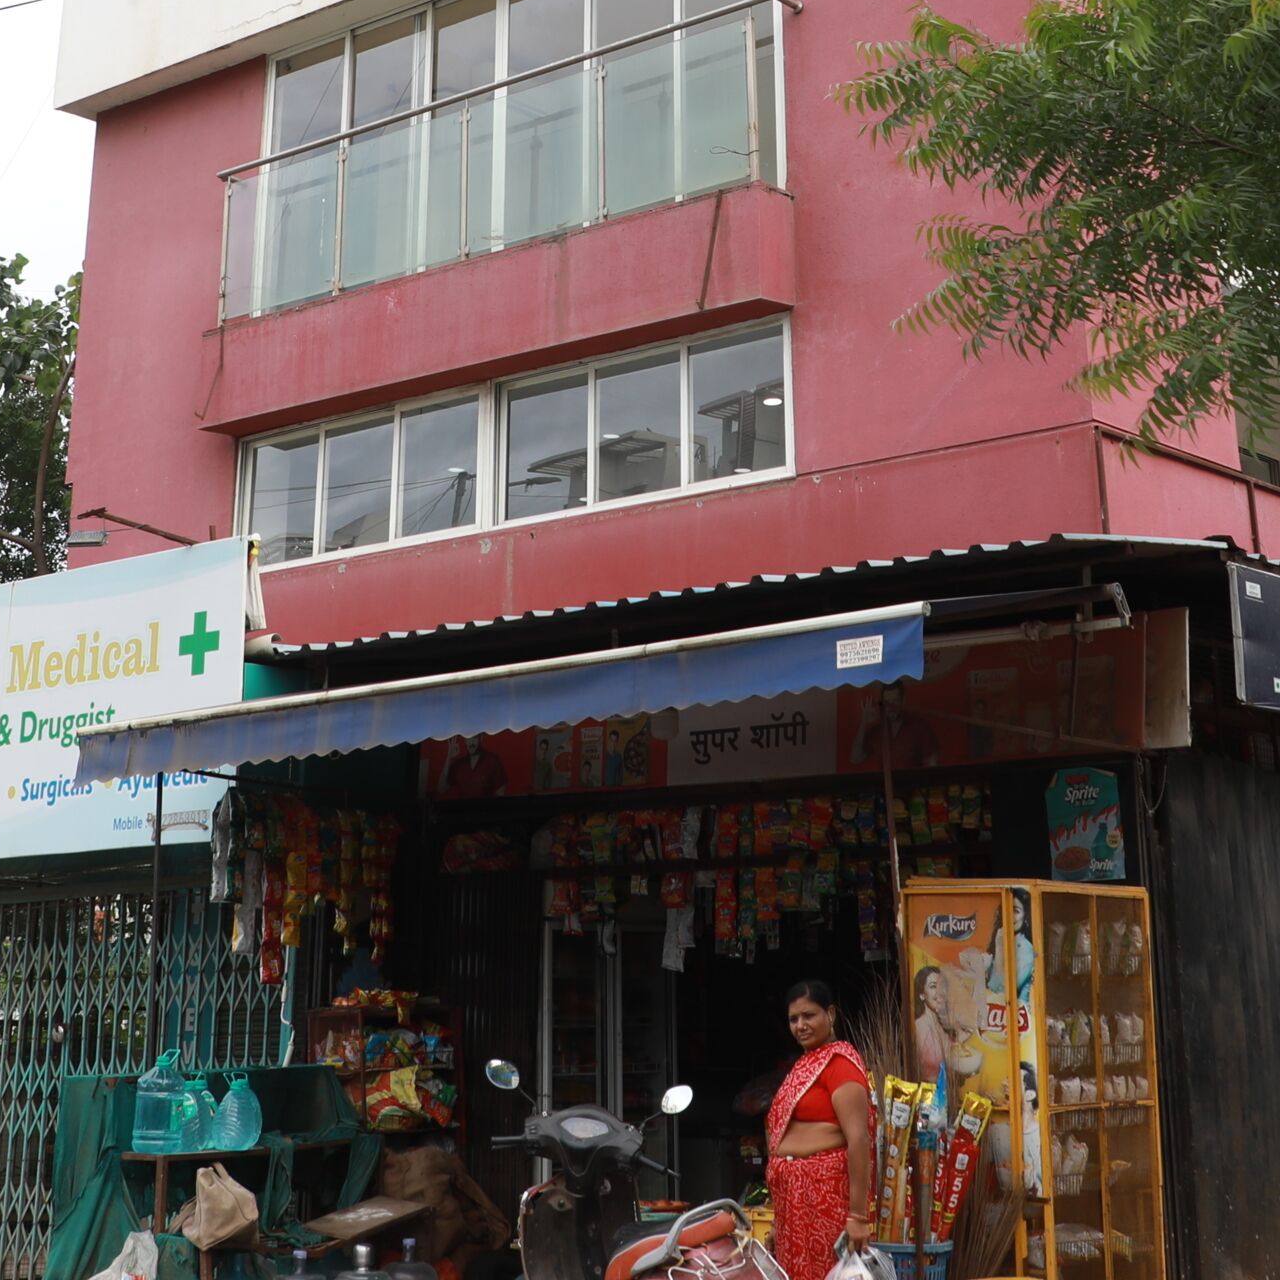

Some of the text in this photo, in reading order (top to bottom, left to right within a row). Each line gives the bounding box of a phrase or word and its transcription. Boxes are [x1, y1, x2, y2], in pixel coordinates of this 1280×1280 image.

[5, 622, 160, 694] Medical
[19, 703, 115, 748] Druggist
[690, 711, 809, 763] सुपर शॉपी
[1064, 786, 1100, 803] Sprite
[113, 816, 143, 831] Mobile
[927, 914, 976, 938] Kurkure
